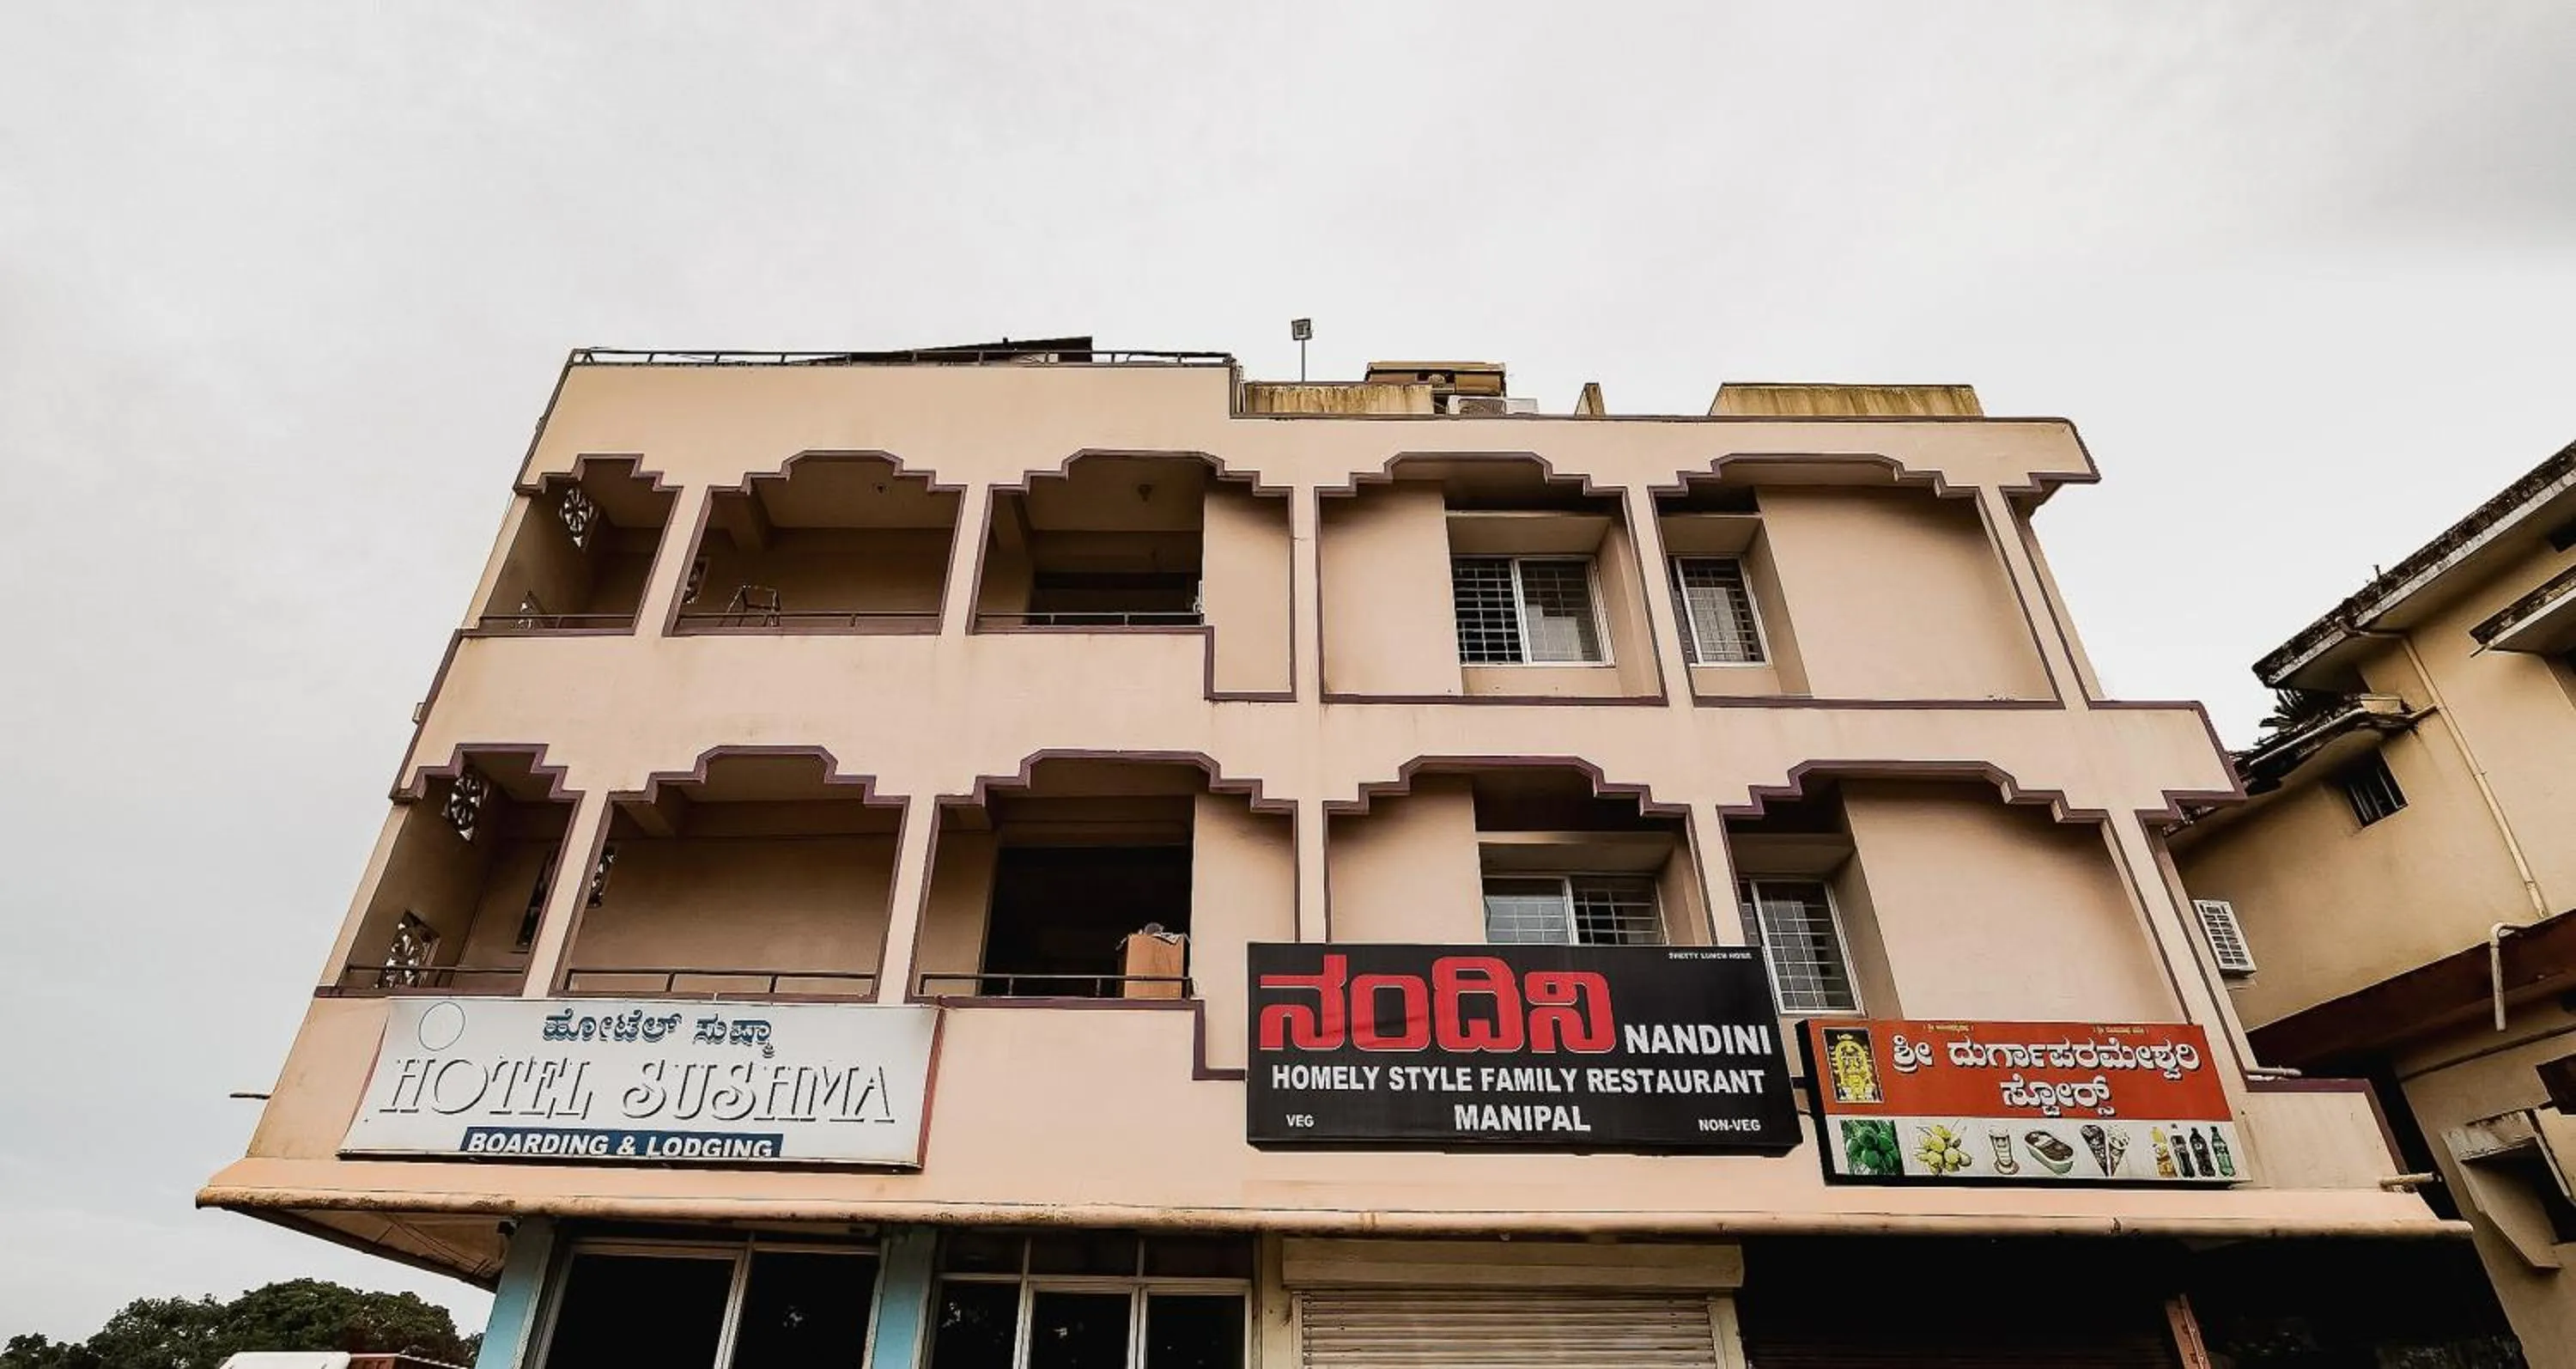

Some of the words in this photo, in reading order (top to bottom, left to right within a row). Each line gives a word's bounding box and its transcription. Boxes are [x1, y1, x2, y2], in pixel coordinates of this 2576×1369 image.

[1260, 954, 1617, 1053] ನಂದಿನಿ
[543, 1008, 683, 1043] ಹೋಟೆಲ್
[692, 1013, 775, 1058] ಸುಷ್ಮಾ
[1625, 1025, 1772, 1056] NANDINI
[1893, 1036, 1933, 1073] ಶ್ರೀ
[379, 1055, 594, 1120] HOTEL
[622, 1059, 896, 1123] SUSHMA
[1271, 1064, 1380, 1091] HOMELY
[1388, 1066, 1473, 1092] STYLE
[1480, 1068, 1578, 1093] FAMILY
[1587, 1068, 1765, 1094] RESTAURANT
[1285, 1114, 1315, 1129] VEG
[1454, 1104, 1592, 1133] MANIPAL
[1698, 1118, 1762, 1133] NON-VEG
[467, 1132, 609, 1155] BOARDING
[617, 1135, 636, 1156] &
[647, 1136, 773, 1158] LODGING
